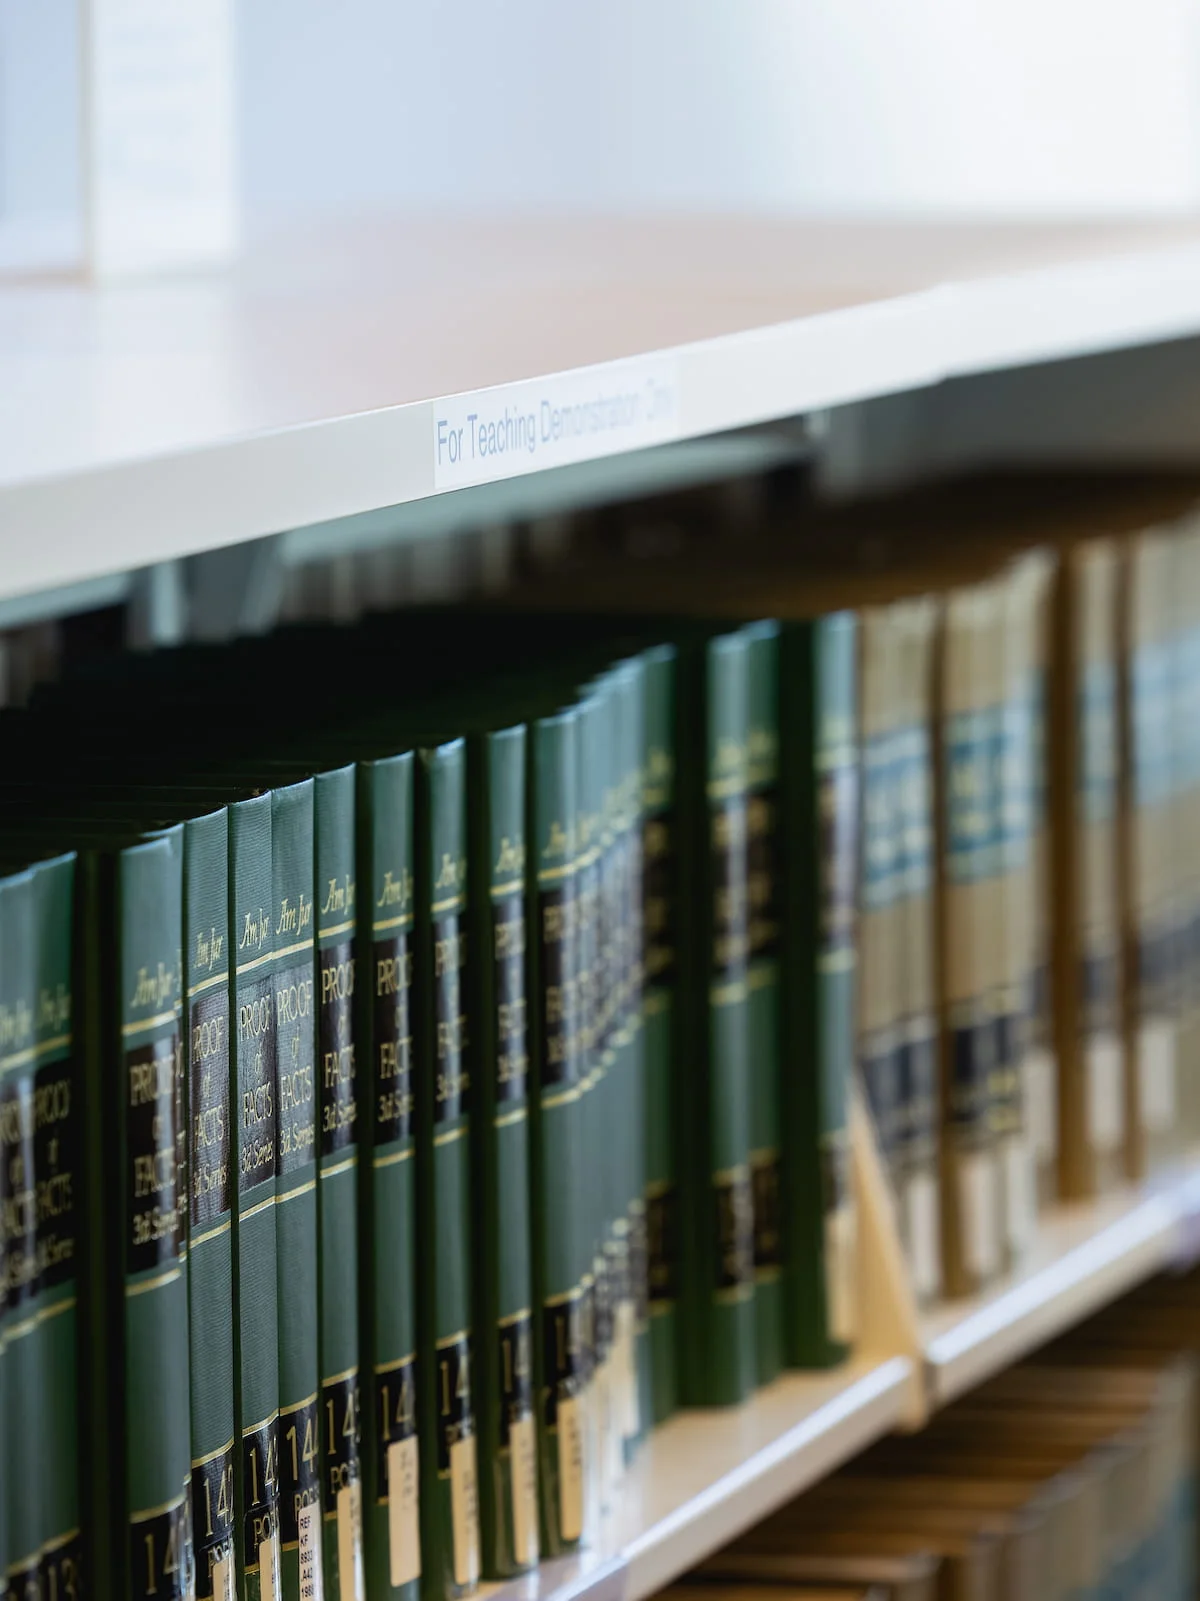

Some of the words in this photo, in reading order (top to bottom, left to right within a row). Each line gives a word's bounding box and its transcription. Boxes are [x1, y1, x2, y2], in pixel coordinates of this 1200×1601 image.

[436, 419, 464, 466] For
[467, 406, 537, 454] Teaching
[321, 958, 355, 1005] PROO
[377, 952, 413, 997] PRO
[240, 994, 271, 1042] PROOF
[276, 979, 312, 1027] PROOF
[129, 1053, 174, 1108] PRO
[380, 1036, 414, 1080] FAC
[243, 1080, 274, 1129] FACTS
[280, 1065, 312, 1112] FACTS
[193, 1104, 225, 1151] FACTS
[279, 1127, 291, 1157] 3d
[291, 1121, 316, 1152] Series
[133, 1147, 176, 1198] FAC
[240, 1143, 252, 1175] 3d
[252, 1137, 274, 1170] Series
[299, 1514, 312, 1530] REF
[299, 1532, 309, 1547] KF
